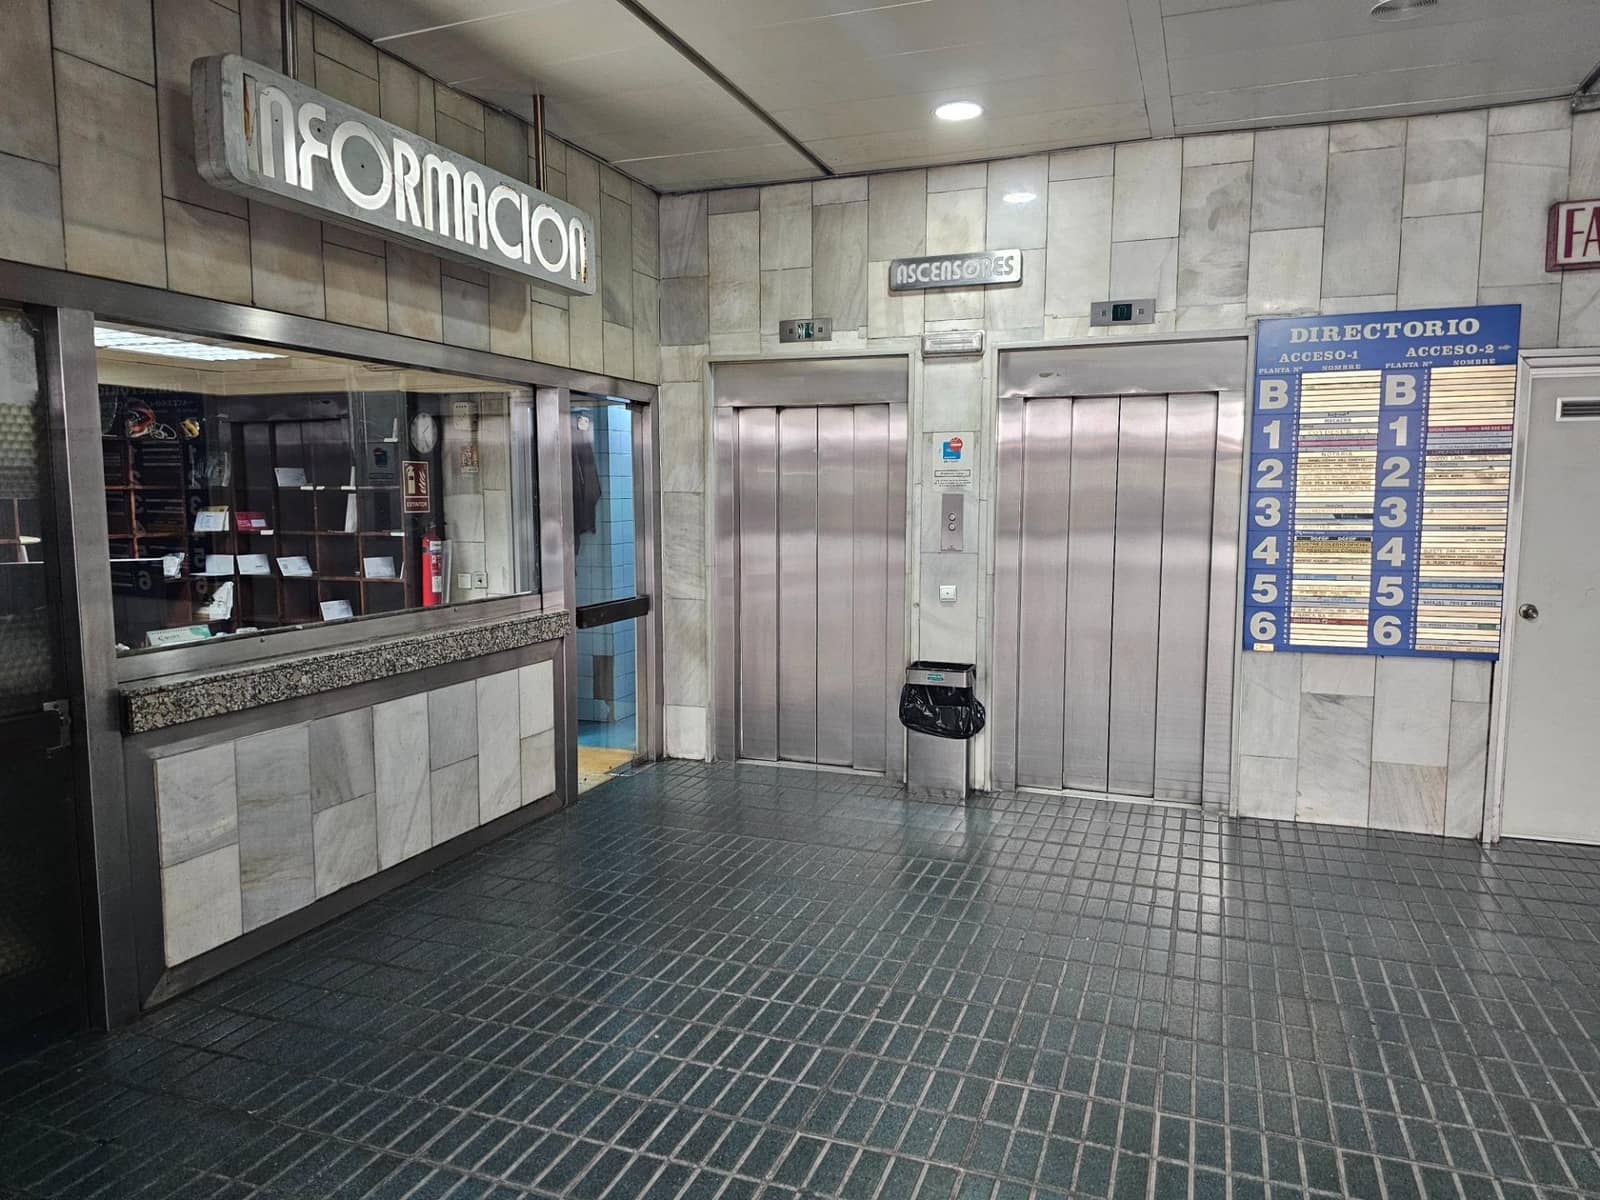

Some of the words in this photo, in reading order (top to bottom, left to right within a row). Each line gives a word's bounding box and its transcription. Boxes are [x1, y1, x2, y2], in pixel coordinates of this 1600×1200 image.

[243, 72, 588, 284] INFORMACION
[896, 255, 1015, 285] ASCENSORES
[1289, 317, 1480, 344] DIRECTORIO
[1279, 350, 1359, 364] ACCESO-1
[1385, 361, 1419, 369] PLANTA
[1406, 343, 1494, 358] ACCESO-2
[1453, 358, 1496, 366] NOMBRE
[1259, 379, 1289, 410] B
[1384, 374, 1417, 406] B
[1263, 419, 1281, 449] 1
[1388, 416, 1408, 446] 1
[1256, 458, 1284, 488] 2
[1381, 456, 1411, 487] 2
[1254, 497, 1281, 527] 3
[1379, 496, 1408, 528] 3
[1252, 536, 1279, 565] 4
[1376, 537, 1406, 567] 4
[1251, 574, 1278, 603] 5
[1375, 576, 1404, 606] 5
[1250, 611, 1277, 640] 6
[1373, 615, 1402, 646] 6
